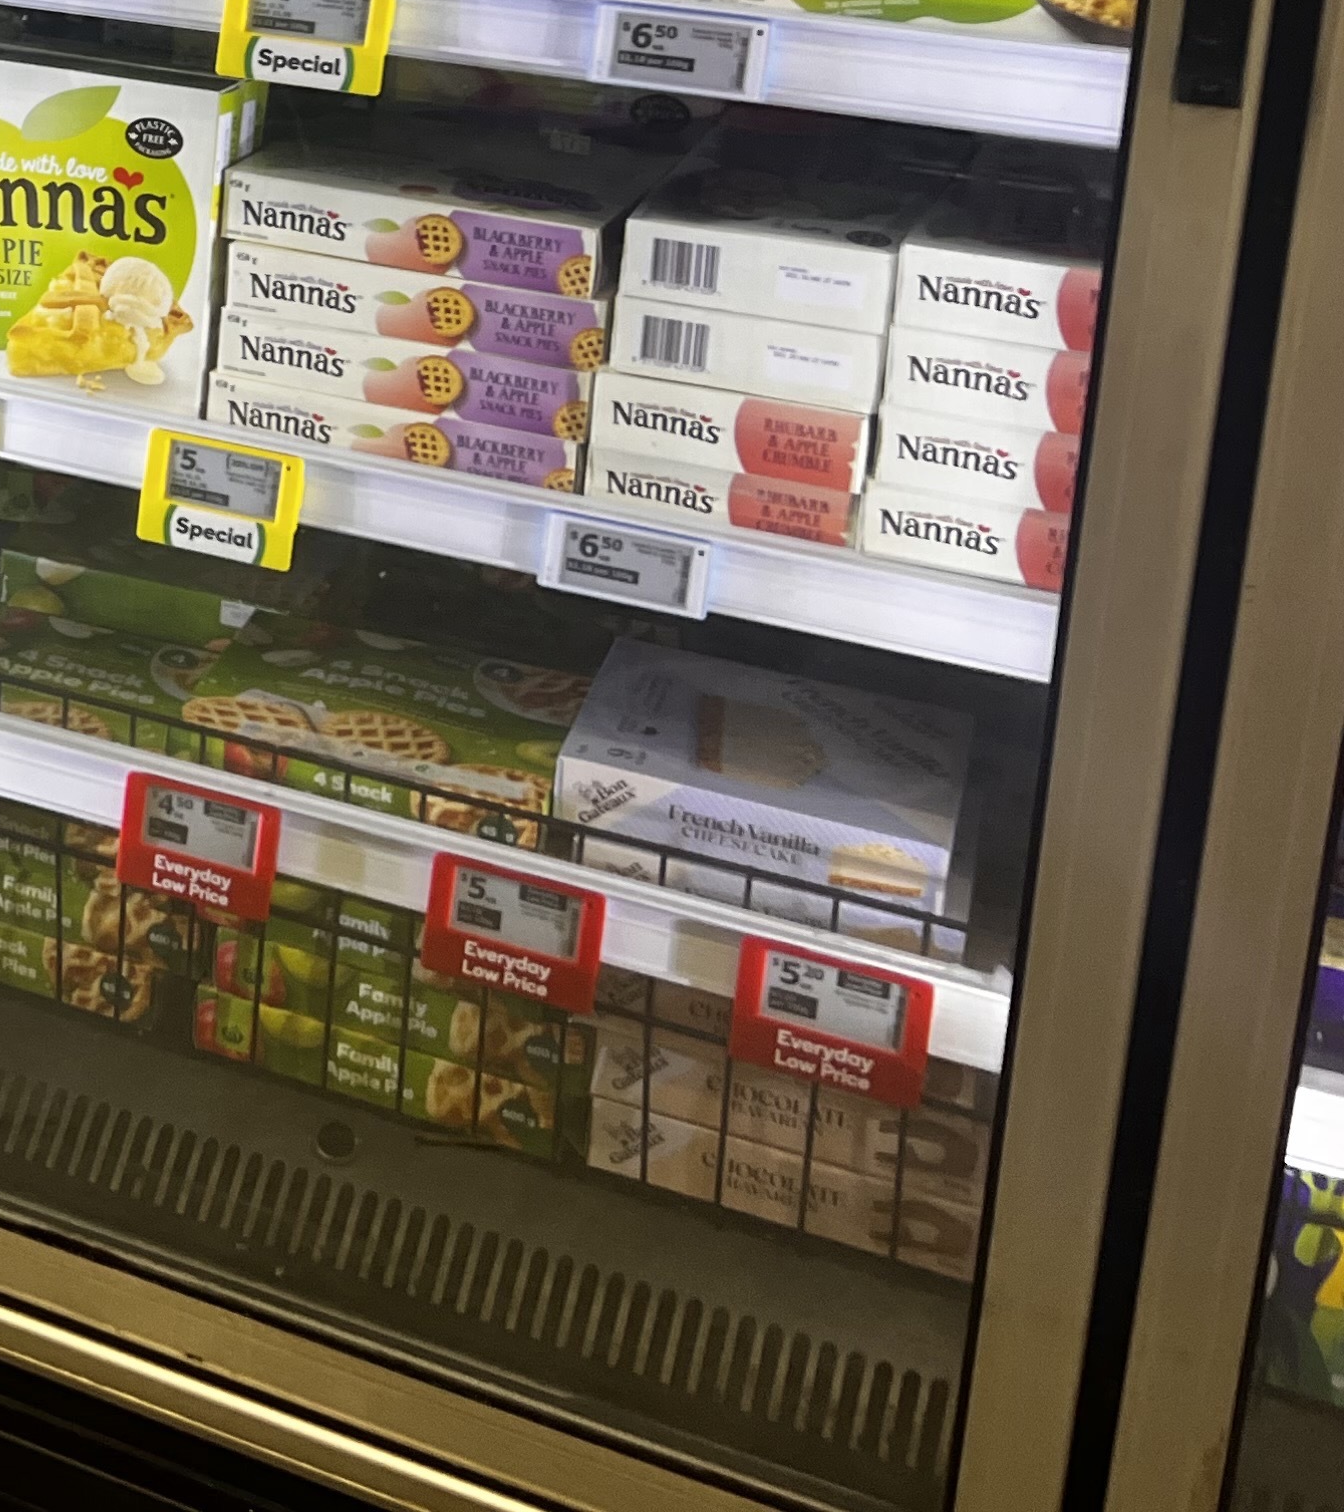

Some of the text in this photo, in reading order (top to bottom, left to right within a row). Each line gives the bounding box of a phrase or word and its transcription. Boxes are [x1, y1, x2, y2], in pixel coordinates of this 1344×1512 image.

[257, 49, 343, 79] Special
[143, 132, 164, 145] FREE
[21, 155, 63, 176] with
[66, 157, 108, 182] love
[3, 240, 44, 267] PIE
[473, 227, 563, 253] BLACKBERRY
[490, 244, 545, 265] & APPLE
[763, 419, 840, 444] RHUBARB
[175, 516, 253, 549] Special
[668, 804, 820, 856] French Vanilla
[151, 870, 228, 907] Low Price
[153, 854, 232, 890] Everyday
[460, 958, 548, 998] Low Price
[463, 940, 553, 983] Everyday
[774, 1045, 870, 1088] Low Price
[777, 1029, 875, 1072] Everyday
